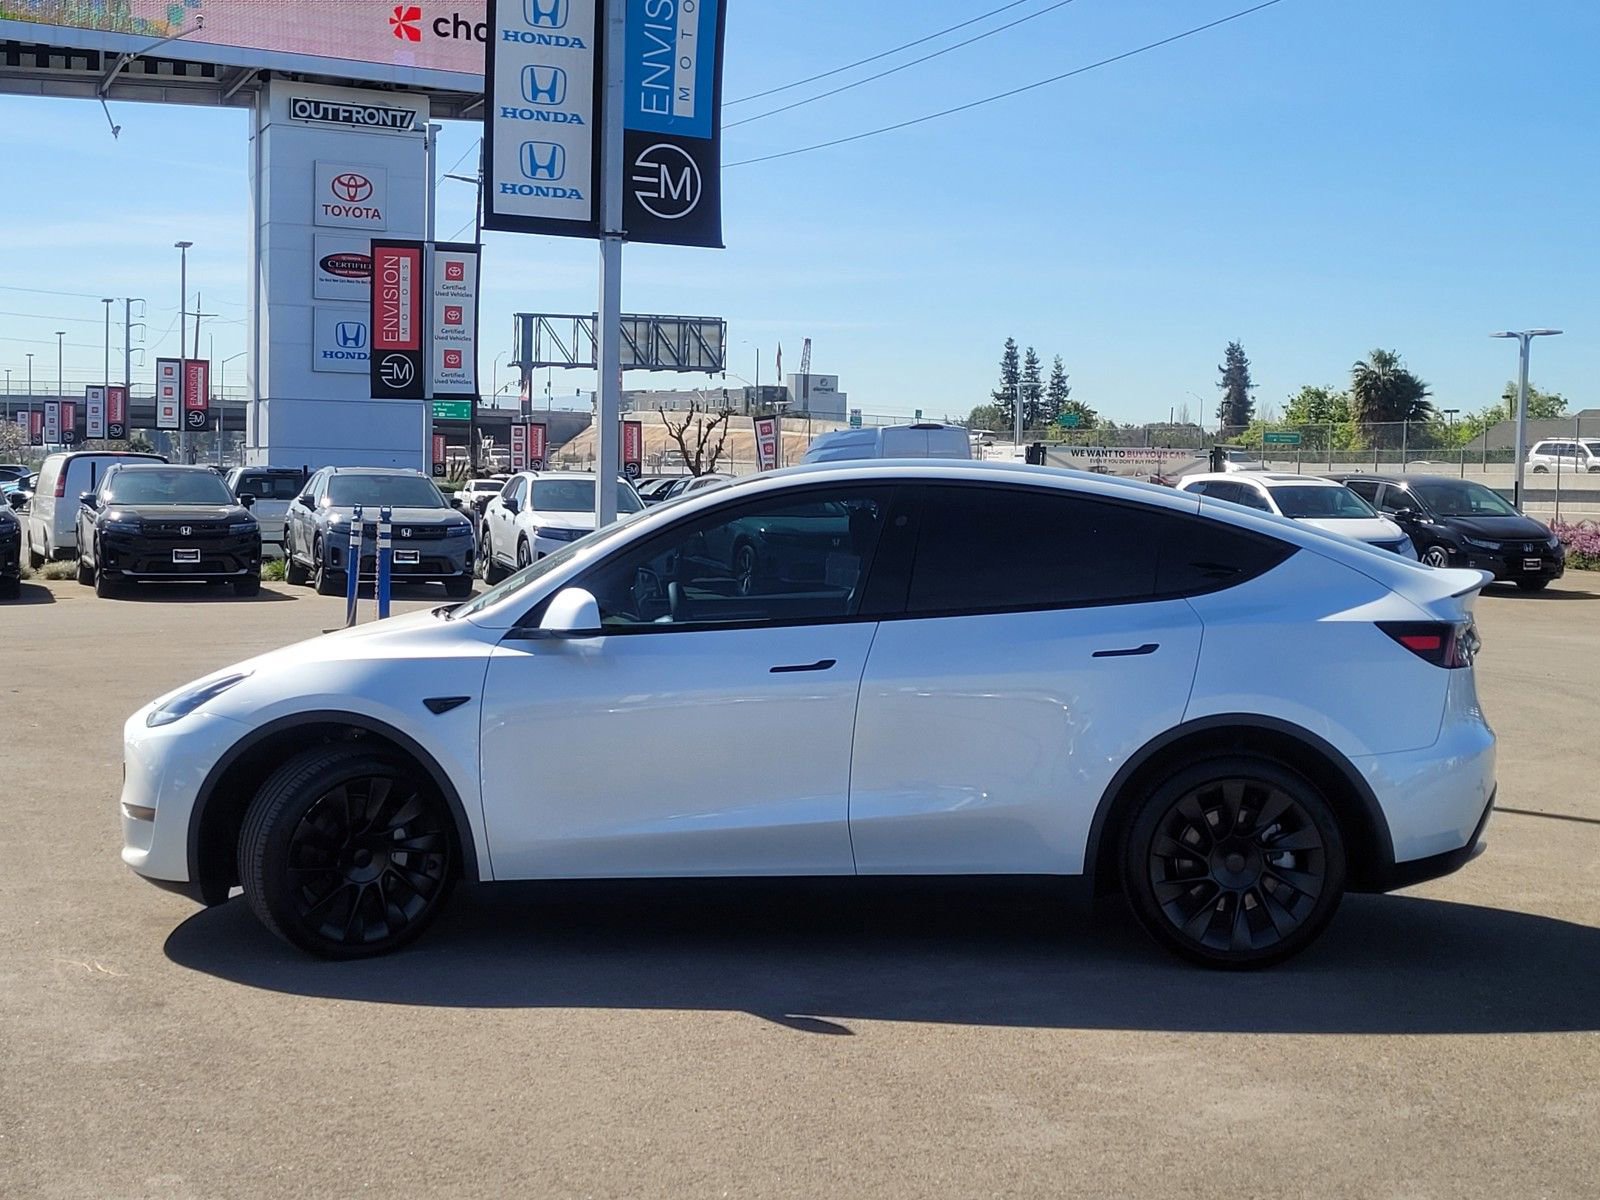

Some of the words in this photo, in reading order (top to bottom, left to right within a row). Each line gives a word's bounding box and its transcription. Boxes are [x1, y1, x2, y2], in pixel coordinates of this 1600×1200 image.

[503, 29, 587, 49] HONDA
[501, 107, 585, 125] HONDA
[500, 183, 584, 200] HONDA
[322, 204, 381, 220] TOYOTA
[383, 255, 398, 342] ENVISION
[401, 264, 409, 335] MOTORS
[1071, 449, 1085, 457] WE
[1086, 449, 1114, 458] WANT
[1115, 450, 1126, 458] TO
[1126, 450, 1144, 458] BUY
[1144, 450, 1168, 458] YOUR
[1169, 451, 1186, 459] CAR
